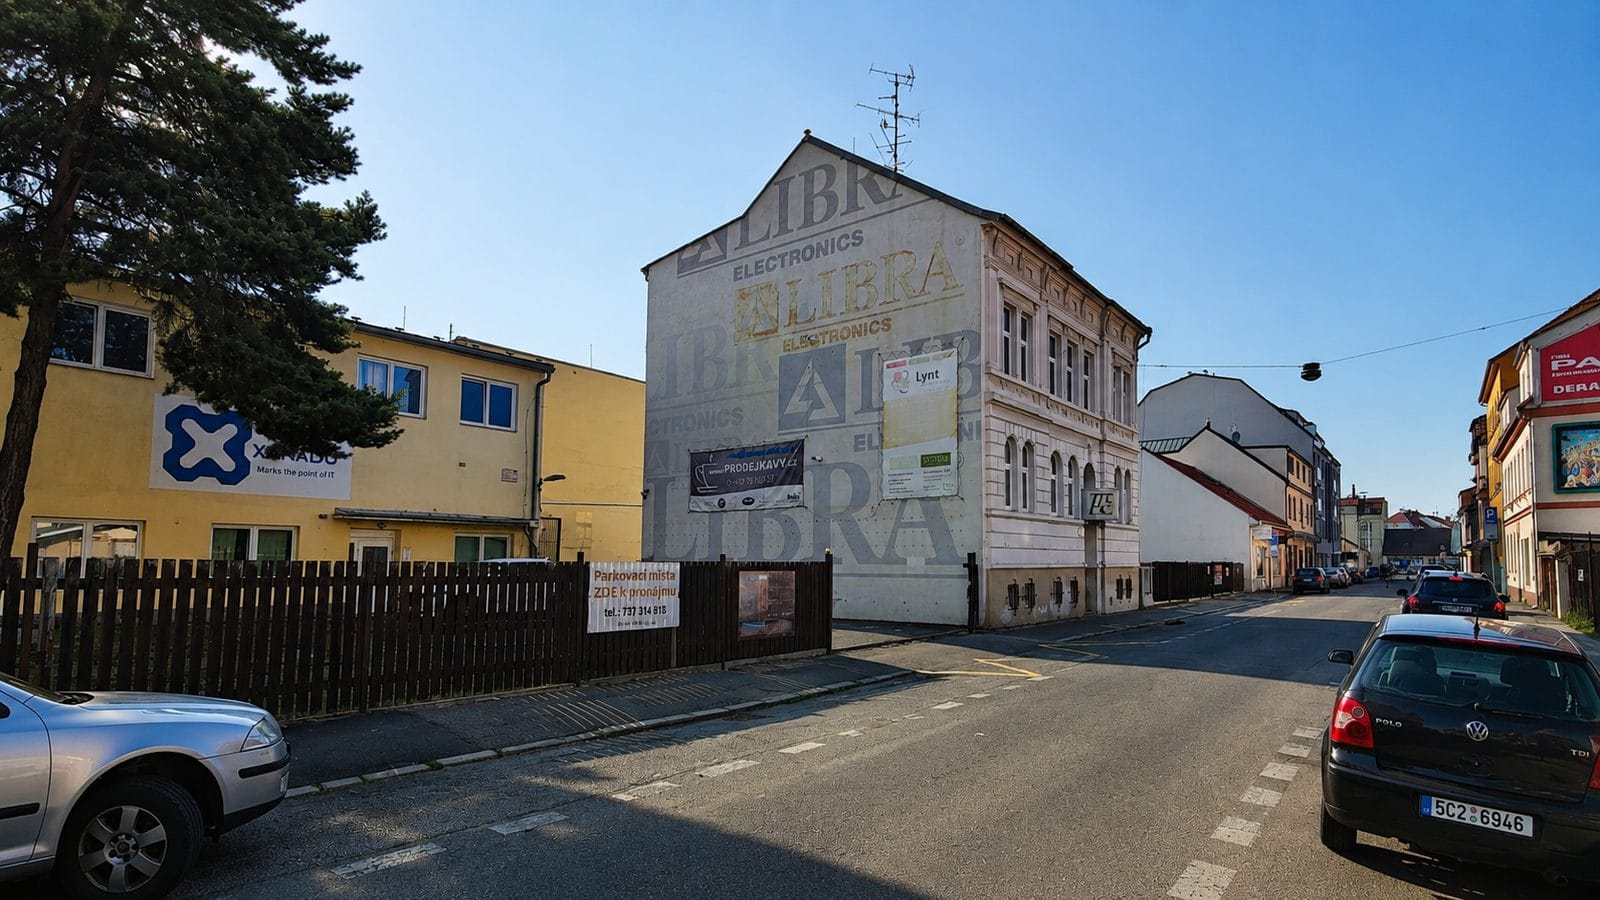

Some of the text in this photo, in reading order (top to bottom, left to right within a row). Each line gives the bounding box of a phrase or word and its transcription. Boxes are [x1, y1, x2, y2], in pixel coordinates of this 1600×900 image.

[735, 162, 904, 251] LIBR
[733, 229, 864, 282] ELECTRONICS
[784, 240, 964, 328] LIBRA
[783, 317, 893, 353] ELECTRONICS
[916, 369, 940, 384] Lynt
[257, 465, 281, 475] Marks
[284, 467, 297, 476] the
[298, 469, 318, 478] point
[319, 470, 327, 478] of
[594, 568, 647, 581] Parkovací
[594, 584, 676, 601] ZDE k pronájmu
[604, 606, 621, 617] tel.:
[622, 606, 636, 617] 737
[639, 605, 652, 616] 314
[1375, 717, 1402, 728] POLO
[1570, 748, 1590, 758] TDI
[1435, 799, 1524, 832] 5C2 6946
